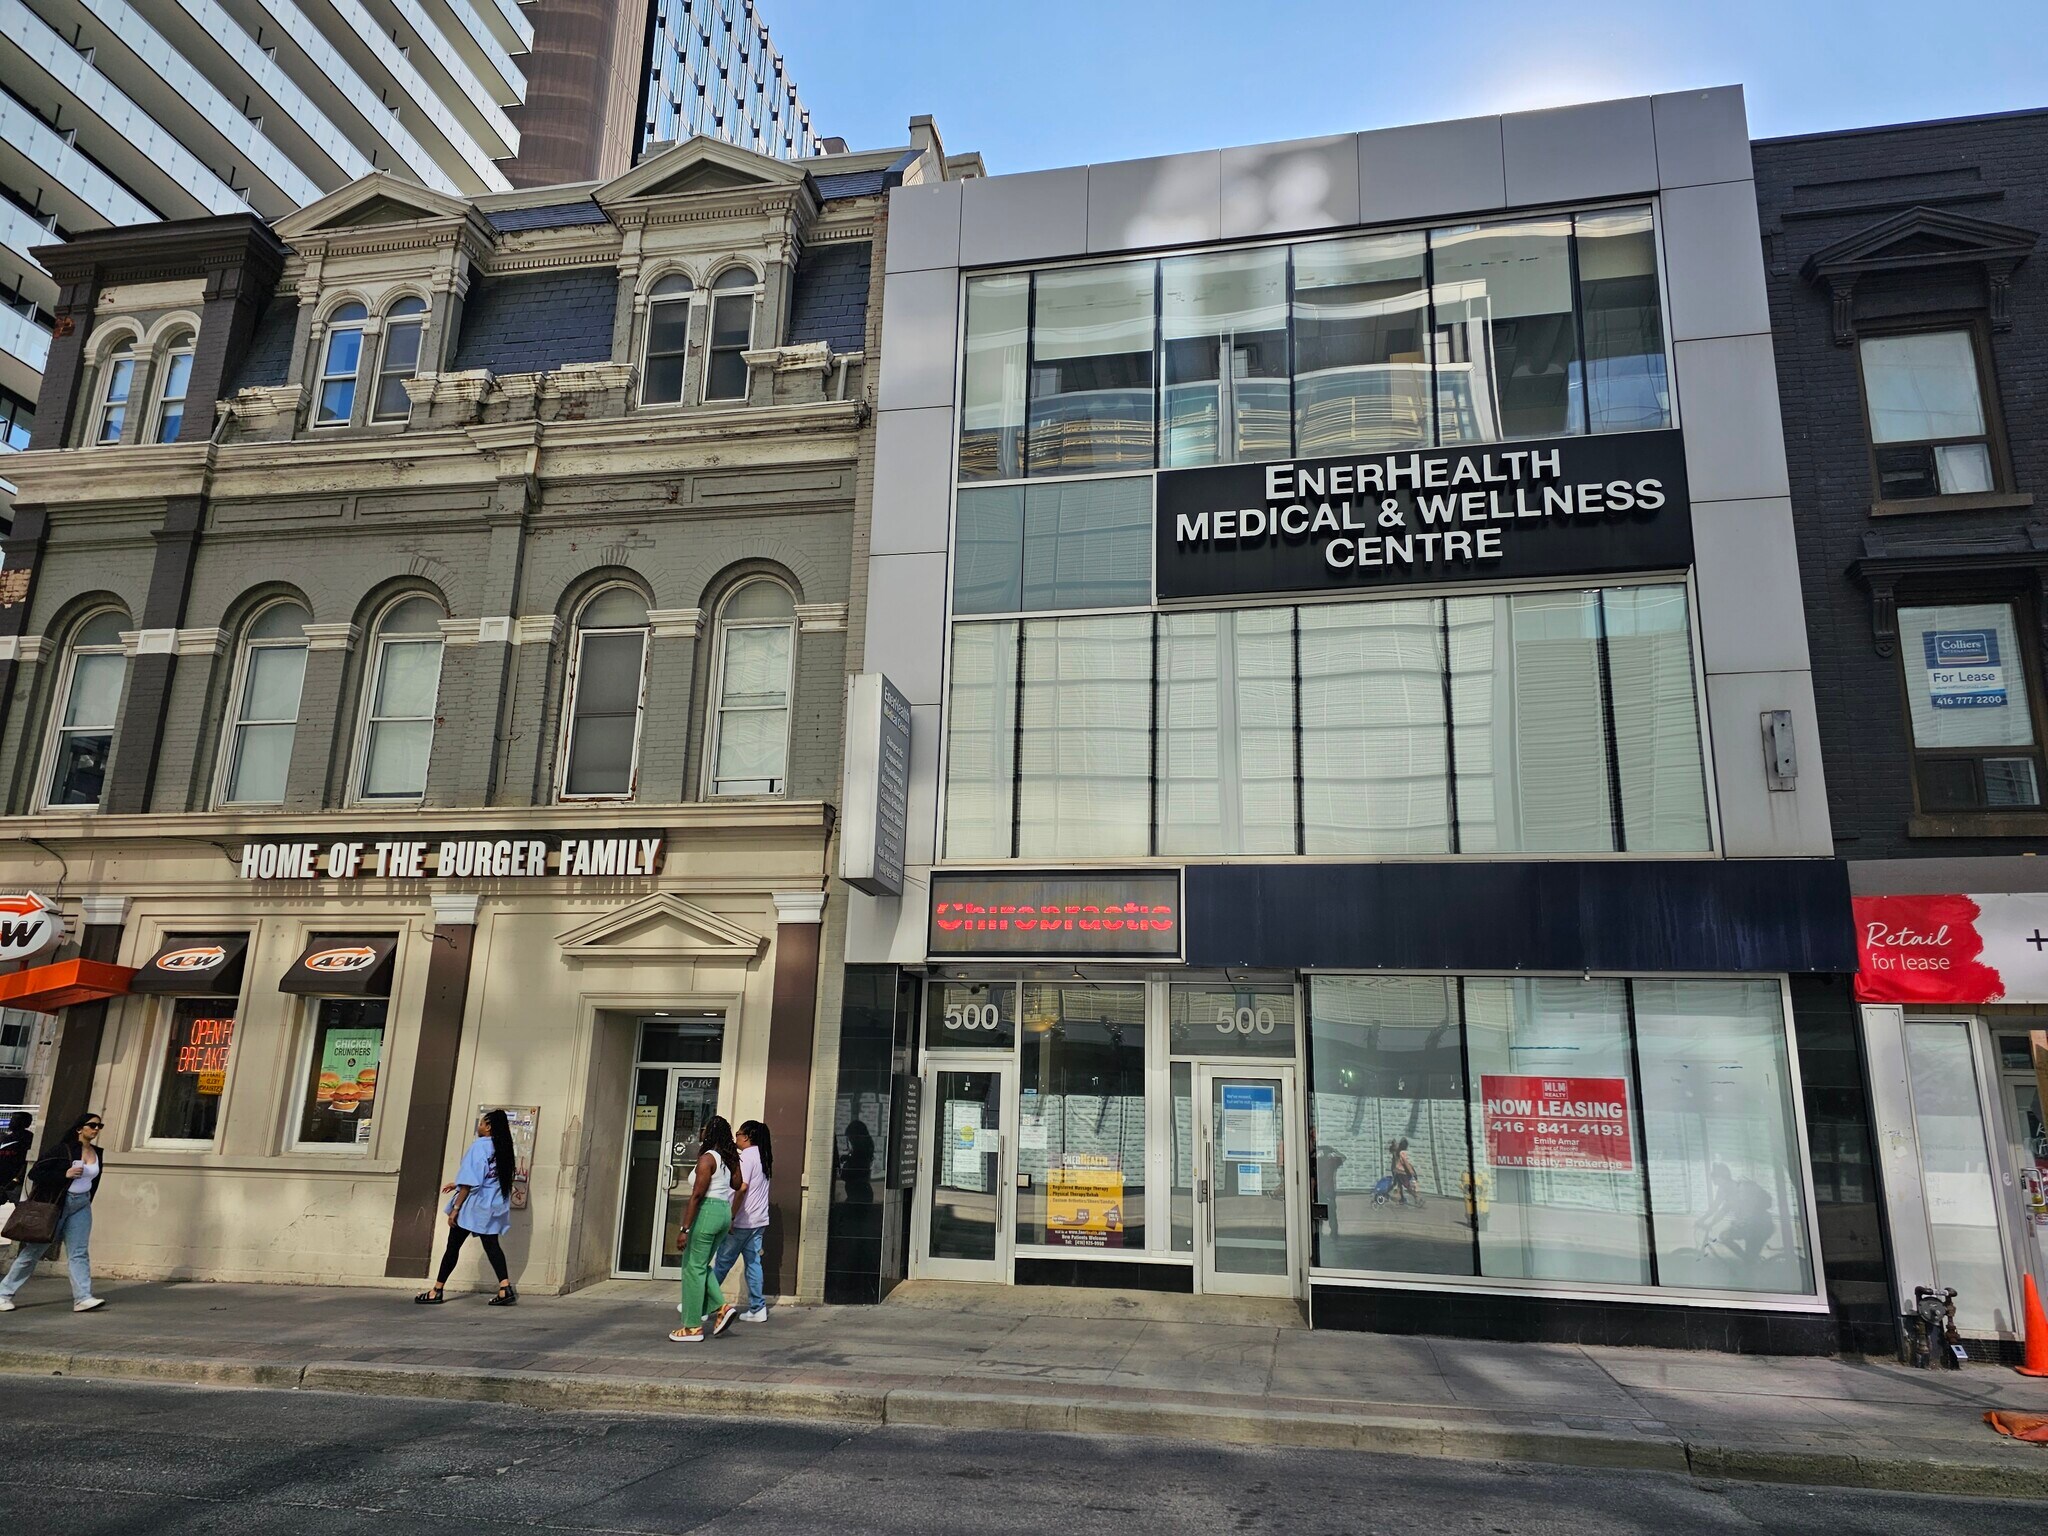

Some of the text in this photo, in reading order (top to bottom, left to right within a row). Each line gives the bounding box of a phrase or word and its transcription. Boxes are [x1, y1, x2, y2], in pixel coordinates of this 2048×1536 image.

[1176, 478, 1666, 542] MEDICAL & WELLNESS
[1326, 528, 1503, 568] CENTRE
[1941, 640, 1981, 650] Colliers
[1933, 671, 1995, 683] For Lease
[1937, 695, 2002, 705] 416 777 2200
[240, 838, 662, 878] HOME OF THE BURGER FAMILY
[936, 903, 1173, 931] Chiropractic
[1866, 922, 1952, 949] Retail
[163, 956, 221, 967] A&W
[313, 956, 370, 967] A&W
[1871, 953, 1950, 970] for lease
[944, 1003, 999, 1031] 500
[1216, 1006, 1275, 1035] 500
[191, 1019, 222, 1045] OPEN
[335, 1039, 372, 1049] CHICKEN
[334, 1048, 371, 1056] CRUNCHERS
[1544, 1082, 1566, 1092] MLM
[1487, 1099, 1623, 1118] NOW LEASING
[1534, 1137, 1580, 1146] Emile Amar
[1498, 1156, 1622, 1170] MLM Realty, Brokerage
